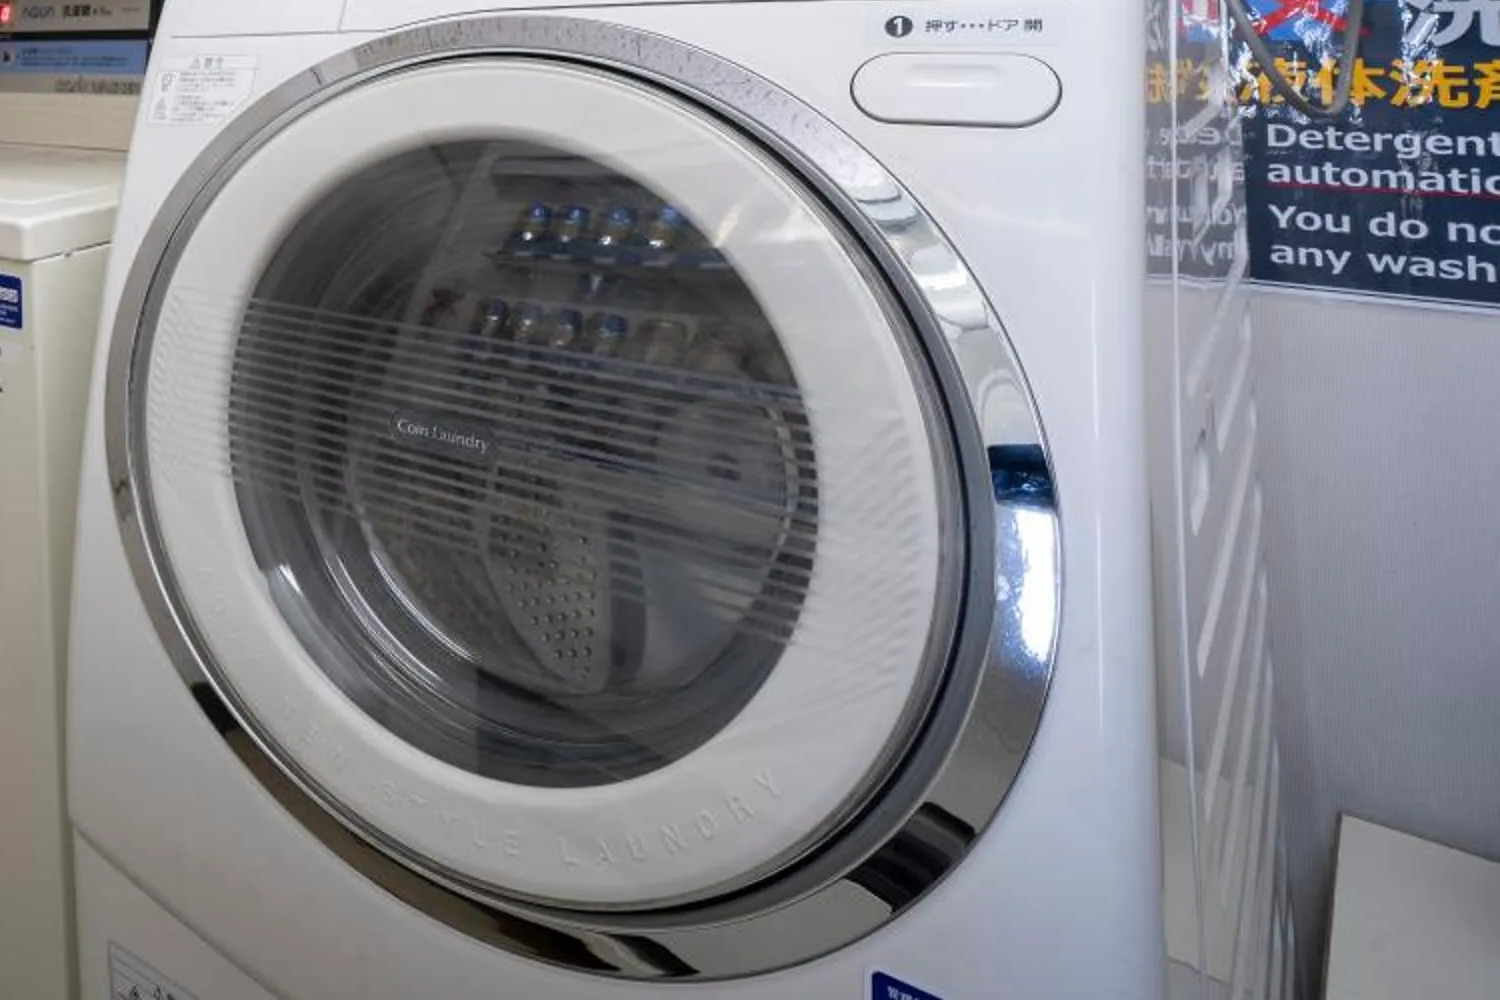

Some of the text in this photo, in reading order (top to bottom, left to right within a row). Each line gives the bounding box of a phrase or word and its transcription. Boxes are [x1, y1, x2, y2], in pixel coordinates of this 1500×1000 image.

[1023, 18, 1044, 32] 開
[1267, 123, 1500, 160] Detergent
[1269, 204, 1350, 234] You
[1368, 211, 1430, 239] do
[1270, 244, 1498, 284] any wash
[397, 418, 487, 456] Coin Laundry
[560, 766, 788, 871] LAUNDRY
